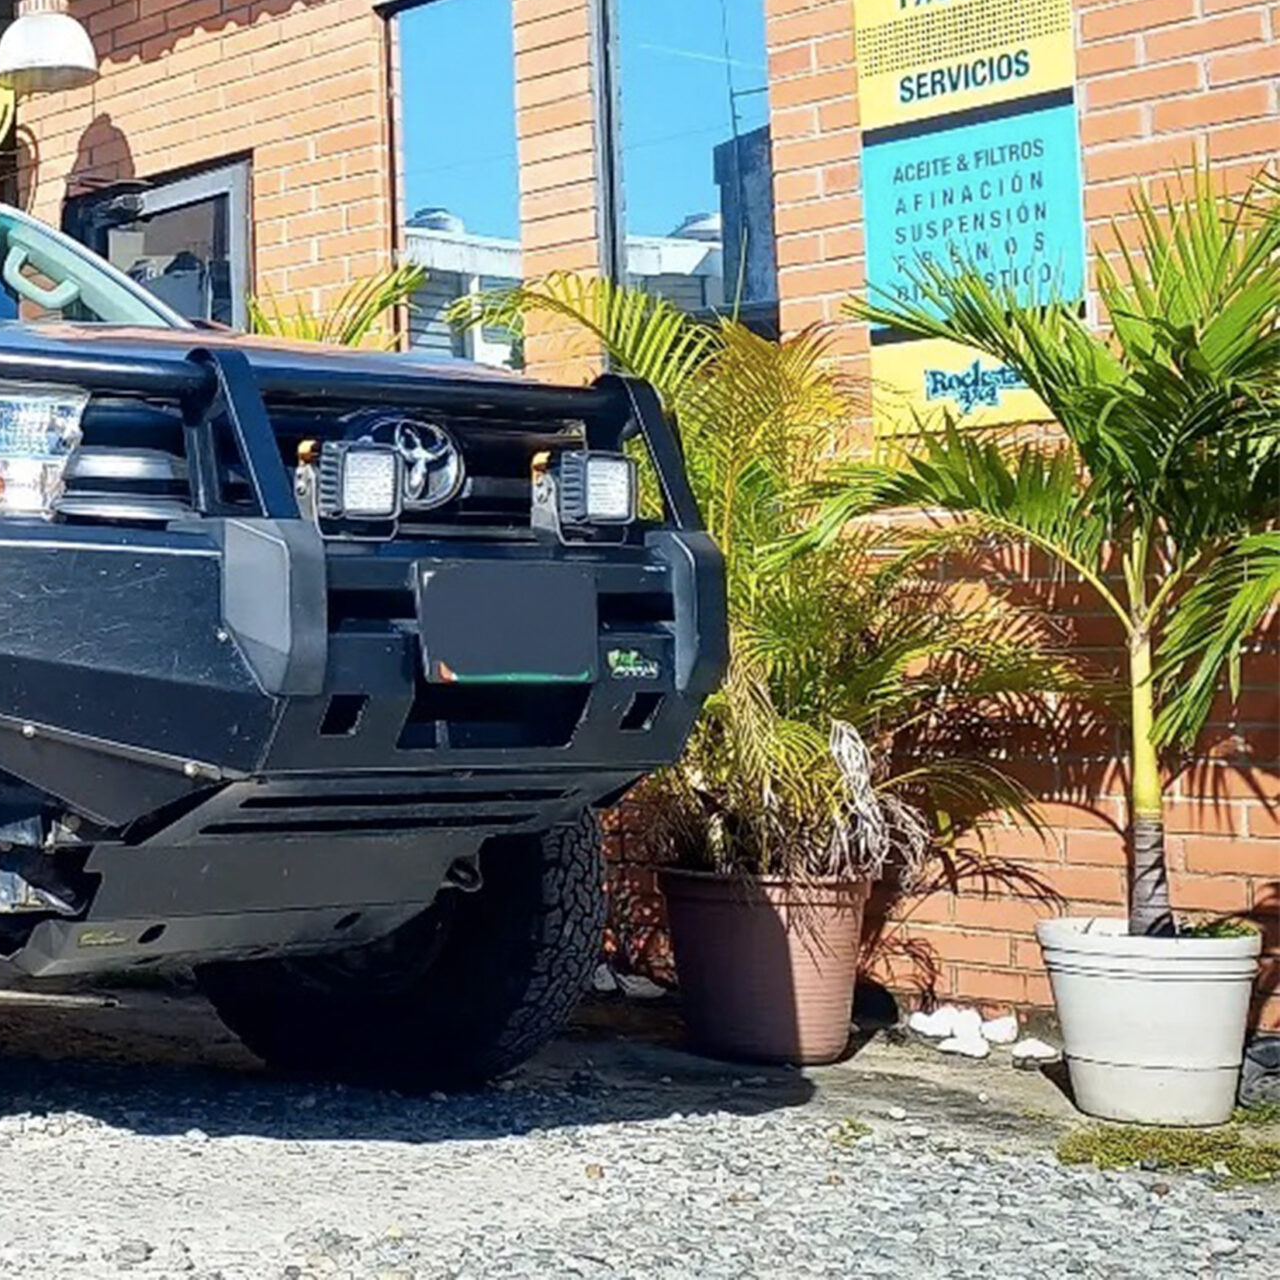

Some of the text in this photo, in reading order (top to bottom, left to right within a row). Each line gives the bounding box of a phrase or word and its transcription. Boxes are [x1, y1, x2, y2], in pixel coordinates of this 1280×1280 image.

[899, 49, 1030, 103] SERVICIOS
[893, 138, 1045, 185] ACEITE & FILTROS
[895, 170, 1044, 215] AFINACIÓN
[895, 200, 1047, 245] SUSPENSIÓN
[925, 359, 1024, 397] Rocksta
